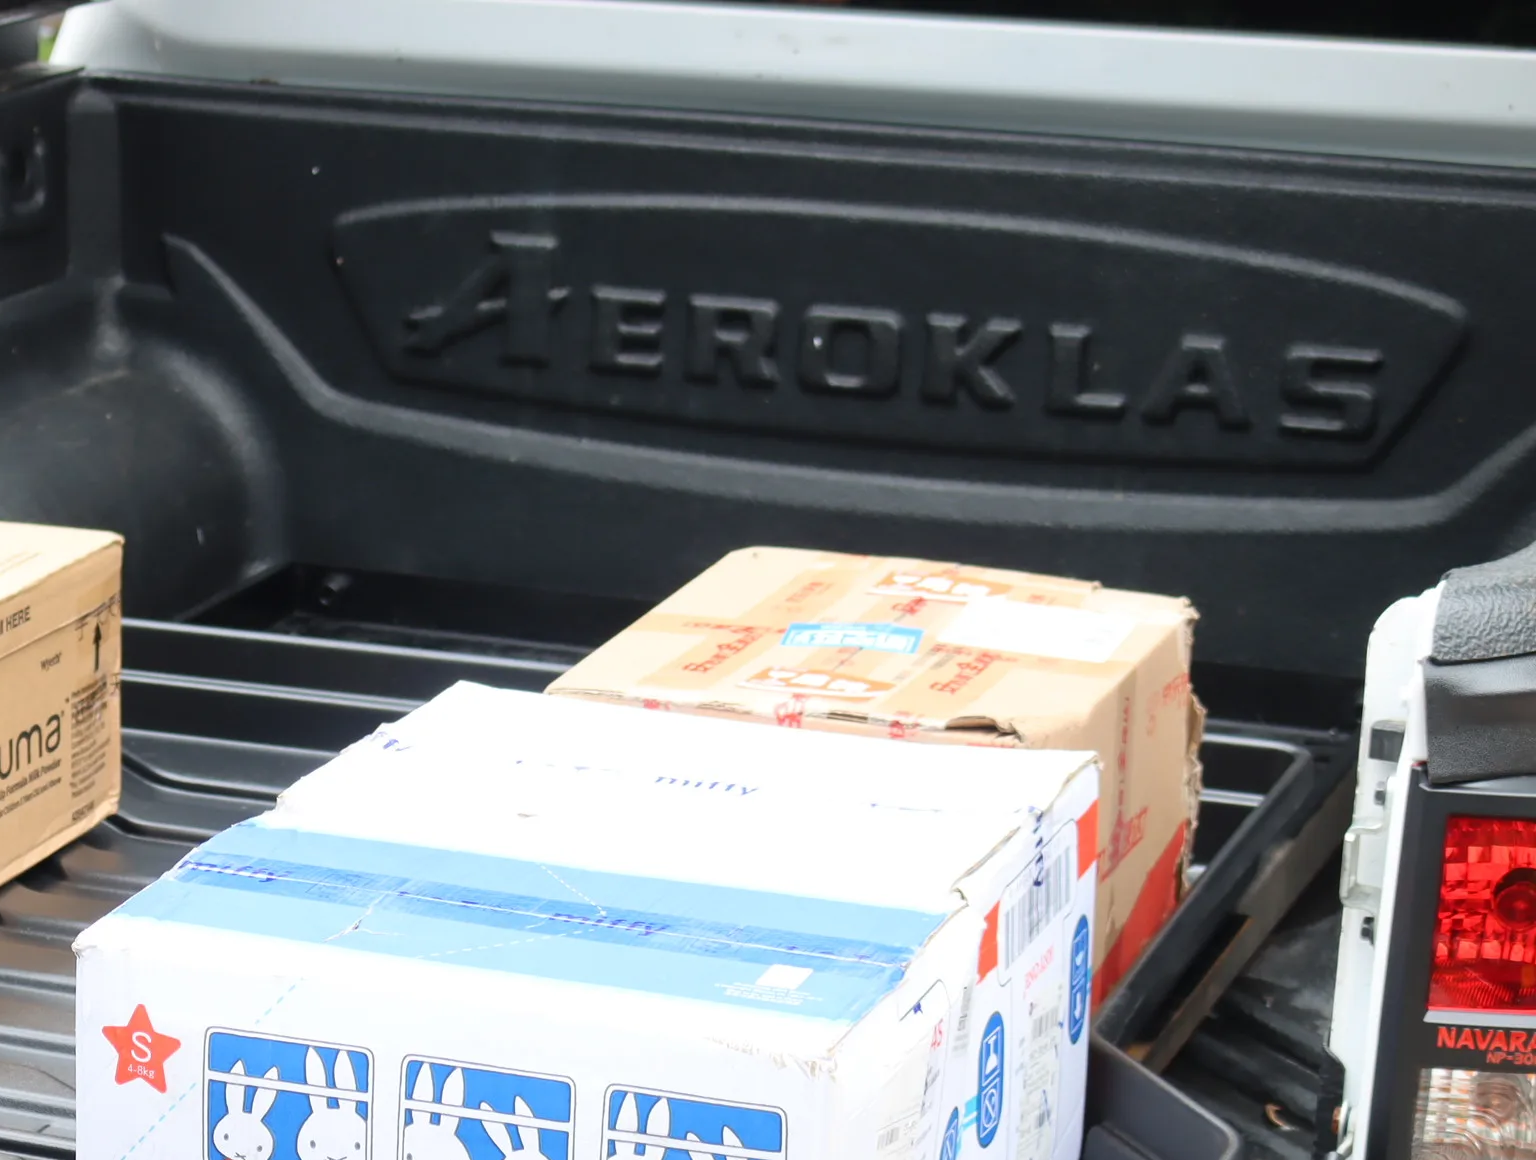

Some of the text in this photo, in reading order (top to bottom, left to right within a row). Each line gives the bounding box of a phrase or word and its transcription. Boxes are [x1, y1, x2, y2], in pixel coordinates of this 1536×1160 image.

[400, 230, 1386, 436] AEROKLAS
[6, 605, 31, 632] HERE
[130, 1031, 152, 1063] S
[1486, 1051, 1536, 1066] NP-30
[127, 1063, 155, 1079] 4-8kg
